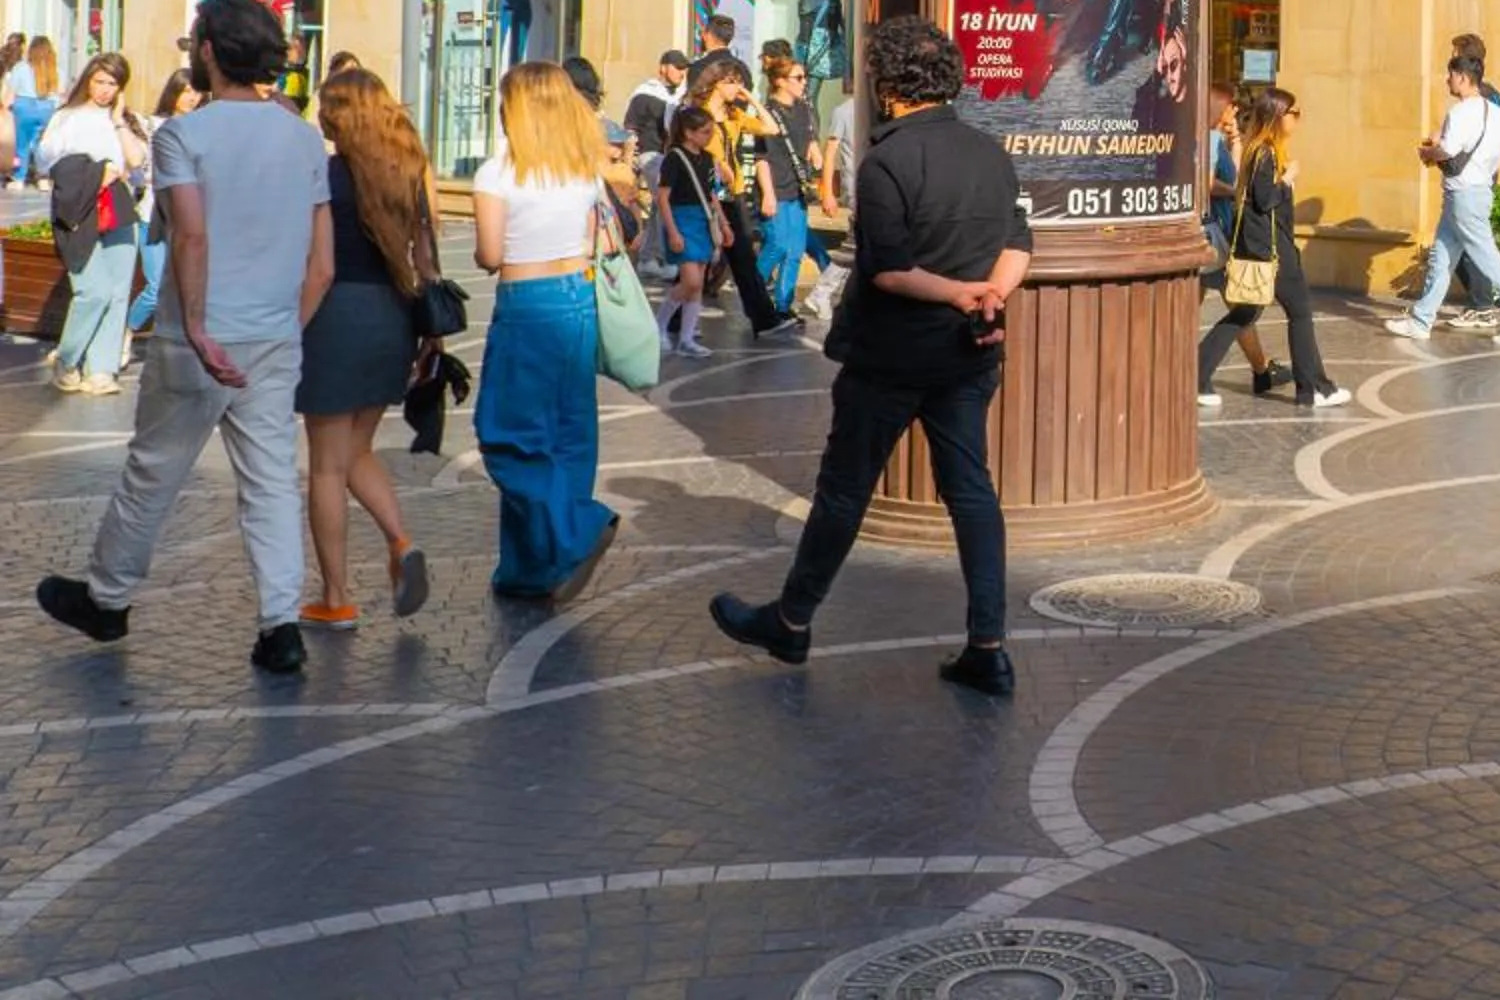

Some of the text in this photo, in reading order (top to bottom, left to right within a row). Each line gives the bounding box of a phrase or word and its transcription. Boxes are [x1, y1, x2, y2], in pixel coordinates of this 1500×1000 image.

[960, 6, 1038, 31] 18 İYUN
[976, 36, 1013, 49] 20:00
[977, 53, 1013, 65] OPERA
[1095, 132, 1174, 155] SAMEDOV
[1067, 187, 1112, 215] 051
[1121, 185, 1158, 213] 303
